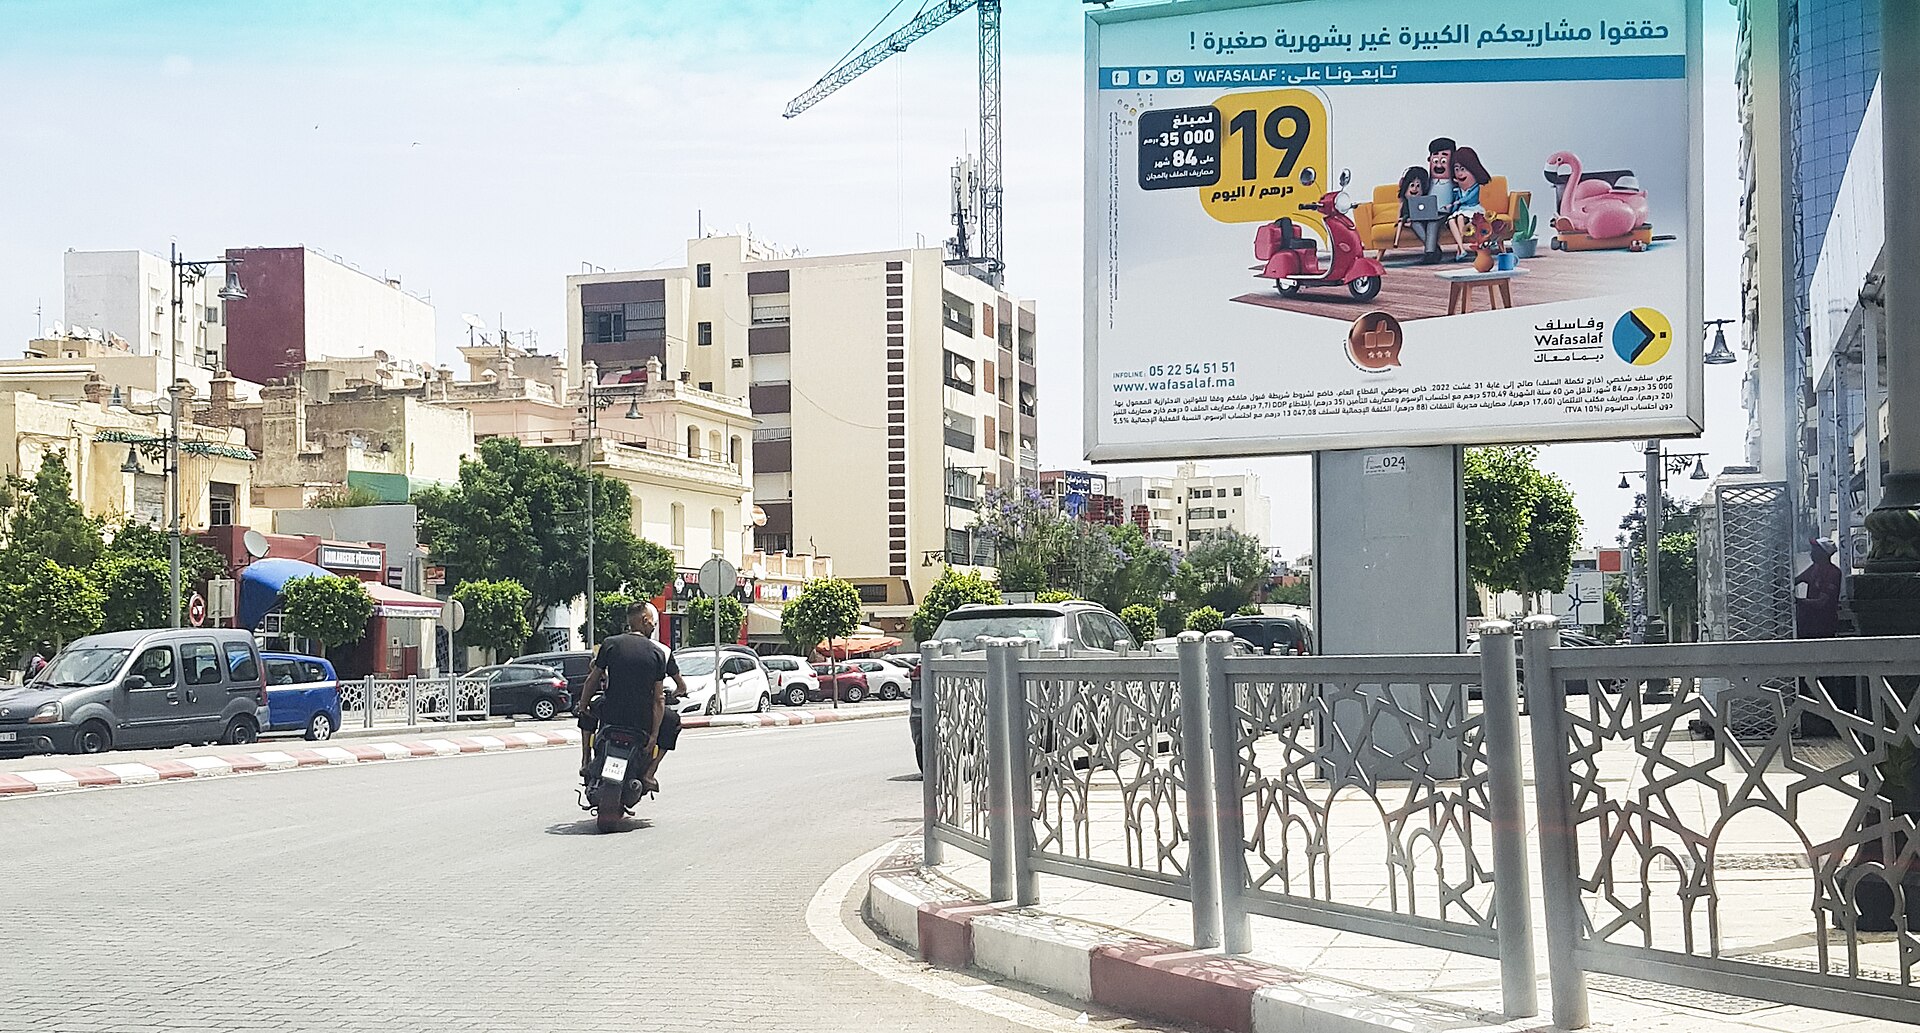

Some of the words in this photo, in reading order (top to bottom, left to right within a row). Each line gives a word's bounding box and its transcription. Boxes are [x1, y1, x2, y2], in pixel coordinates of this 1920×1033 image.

[1275, 24, 1352, 53] بشهرية
[1359, 27, 1391, 51] غير
[1399, 23, 1469, 51] الكبيرة
[1477, 18, 1592, 48] مشاريعكم
[1600, 20, 1668, 45] حققوا
[1204, 31, 1267, 54] صغيرة
[1194, 69, 1277, 83] WAFASALAF
[1326, 65, 1398, 83] تابعونا
[1172, 112, 1213, 128] لمبلغ
[1159, 132, 1179, 147] 35
[1184, 129, 1214, 144] 000
[1230, 105, 1312, 180] 19
[1154, 157, 1170, 168] شهر
[1172, 149, 1197, 167] 84
[1200, 154, 1214, 164] على
[1146, 171, 1168, 181] بالمجان
[1169, 170, 1188, 178] الملف
[1189, 169, 1214, 177] مصاريف
[1212, 186, 1245, 202] اليوم
[1259, 185, 1293, 199] درهم
[1534, 317, 1604, 331] وفاسلف
[1534, 332, 1603, 346] Wafasalaf
[1149, 365, 1164, 376] 05
[1167, 364, 1181, 376] 22
[1185, 363, 1200, 374] 54
[1204, 362, 1217, 374] 51
[1222, 362, 1235, 373] 51
[1113, 377, 1235, 392] www.wafasalaf.ma
[1552, 387, 1562, 395] 60
[1383, 456, 1405, 467] 024
